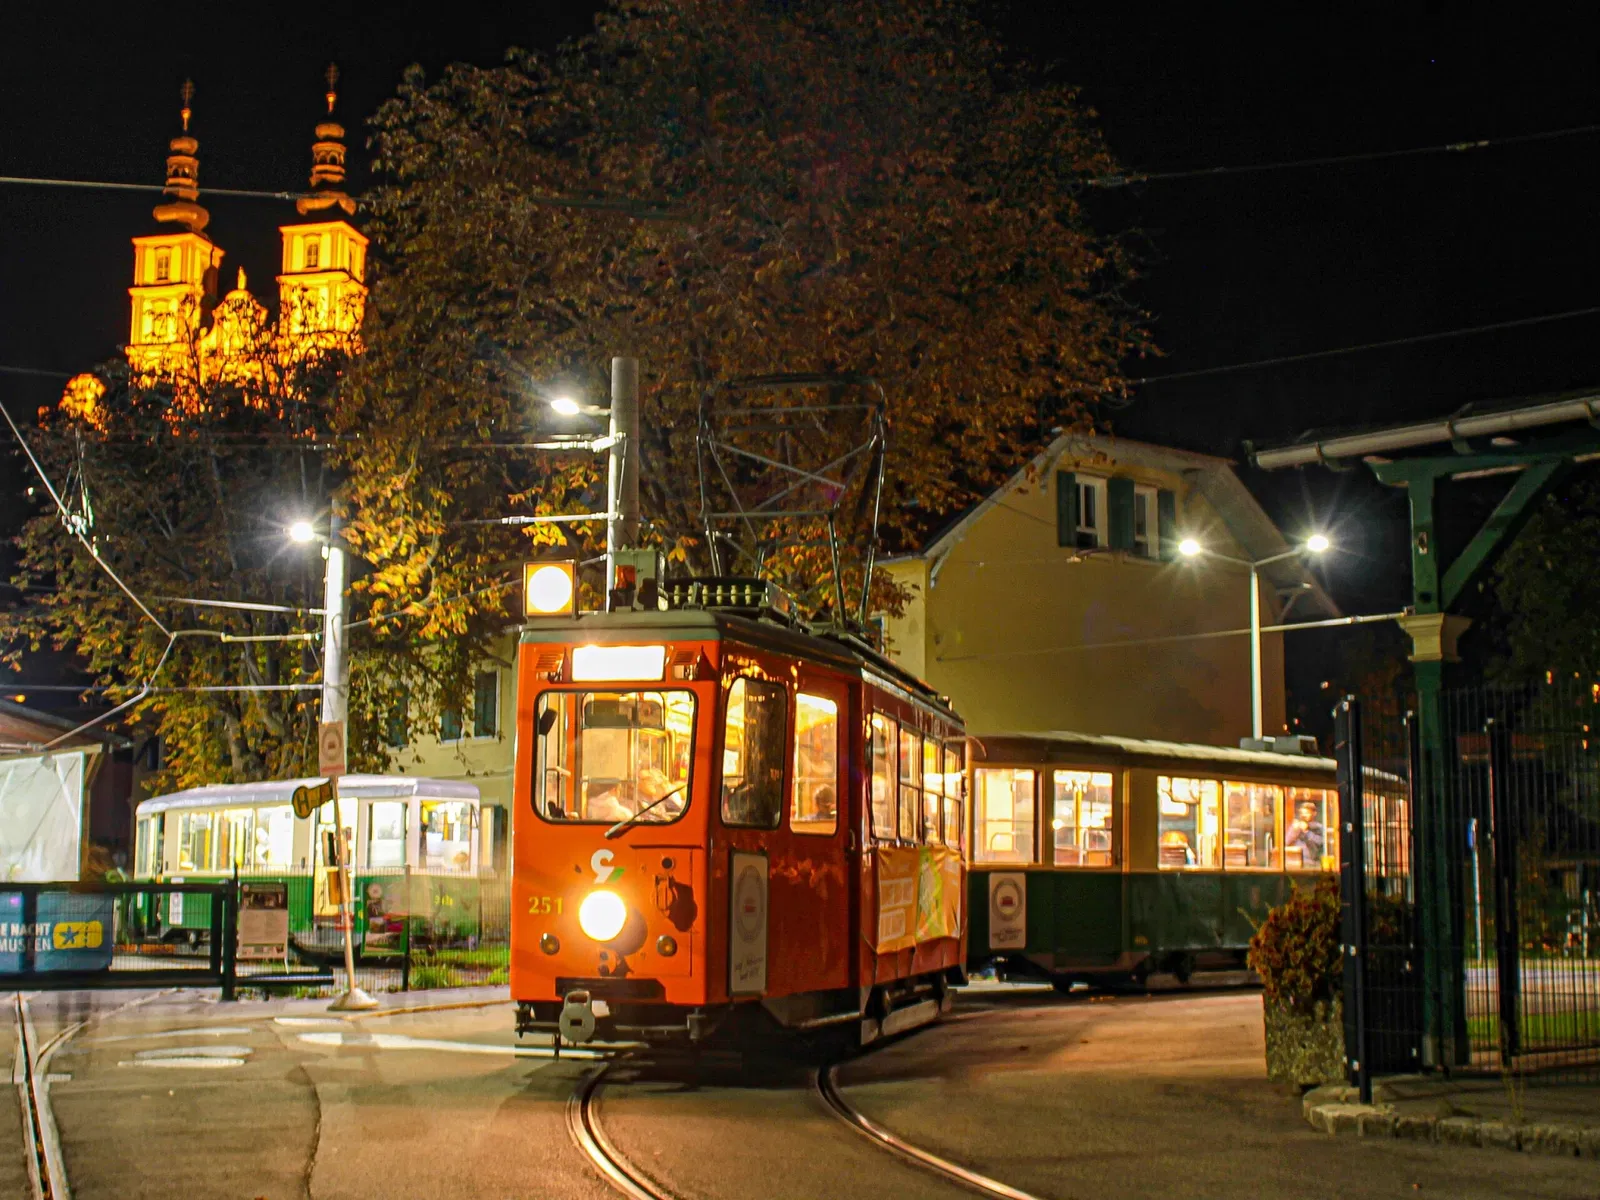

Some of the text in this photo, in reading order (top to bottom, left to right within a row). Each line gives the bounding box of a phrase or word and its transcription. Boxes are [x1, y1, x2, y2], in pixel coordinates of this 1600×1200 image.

[296, 789, 310, 814] H
[528, 896, 563, 915] 251
[0, 938, 51, 952] MUSEN
